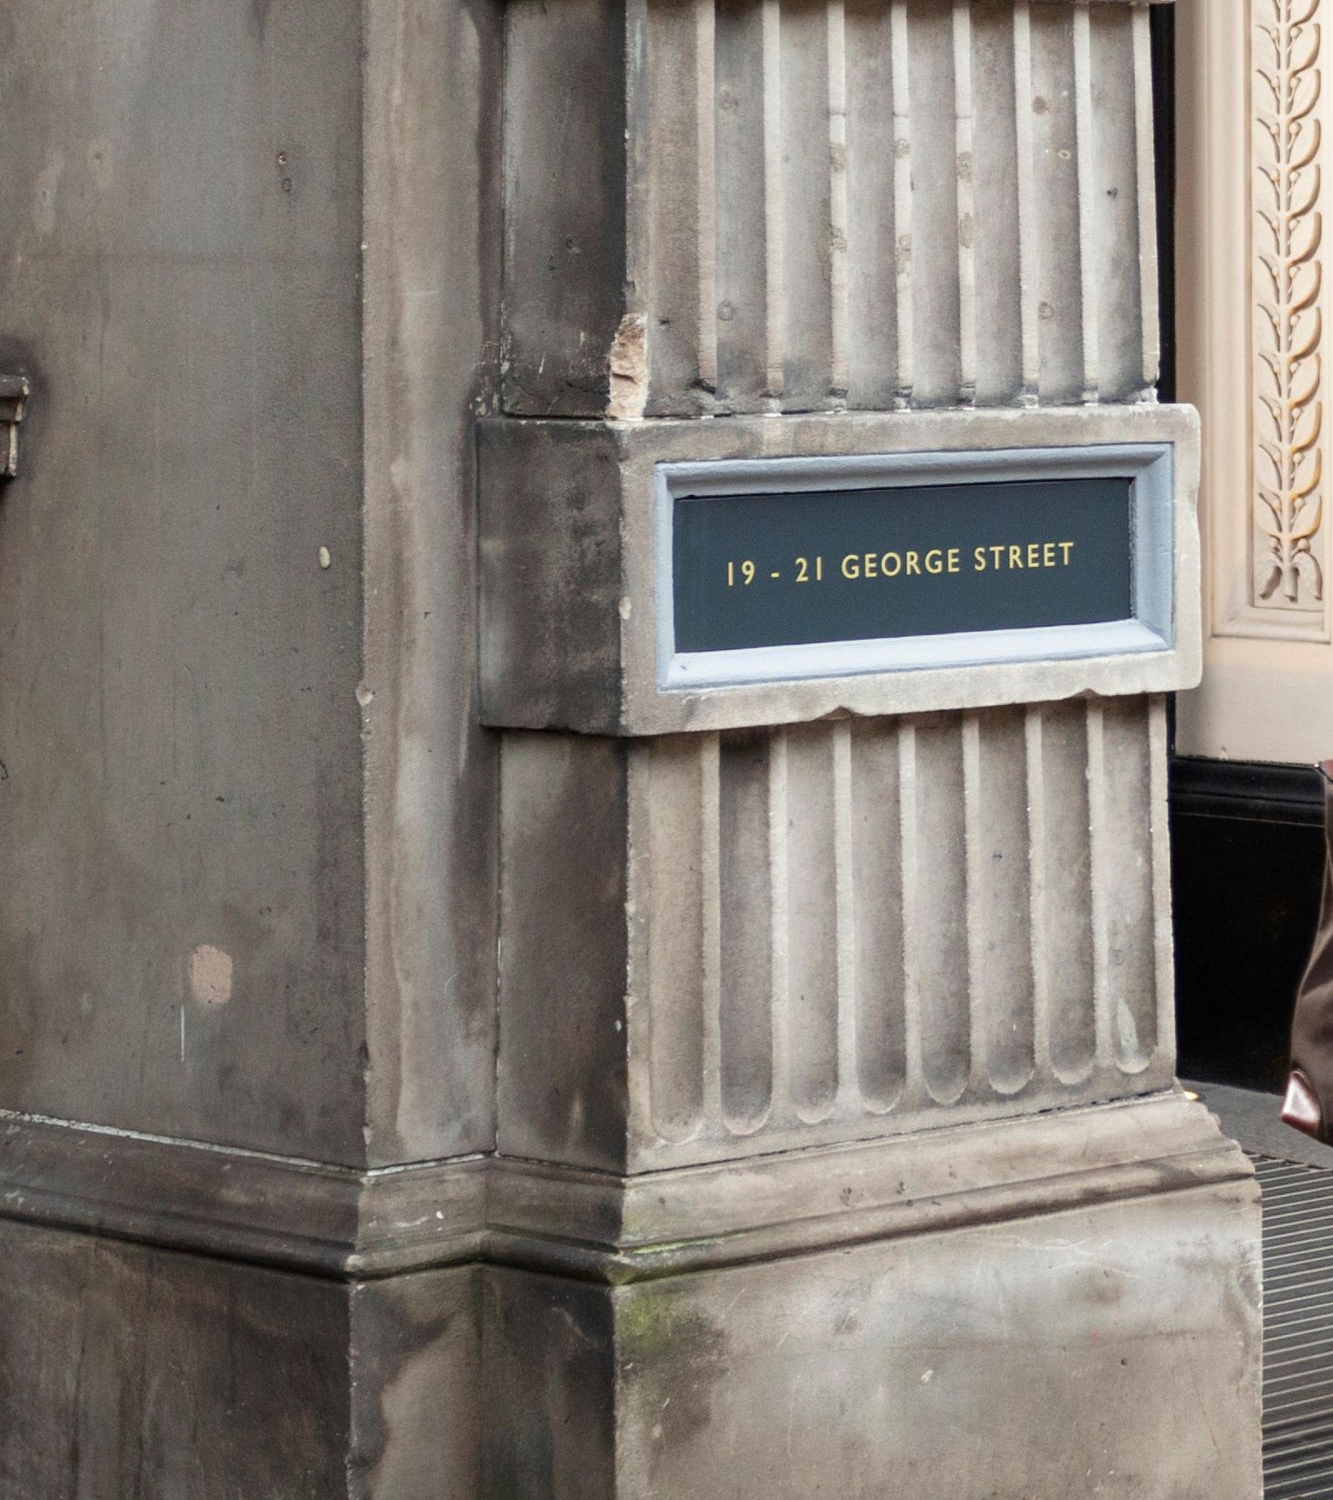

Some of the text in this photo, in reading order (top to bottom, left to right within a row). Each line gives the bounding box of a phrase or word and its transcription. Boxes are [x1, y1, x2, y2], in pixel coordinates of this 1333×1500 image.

[728, 560, 755, 586] 19
[795, 556, 822, 582] 21
[841, 548, 960, 579] GEORGE
[974, 541, 1074, 571] STREET
